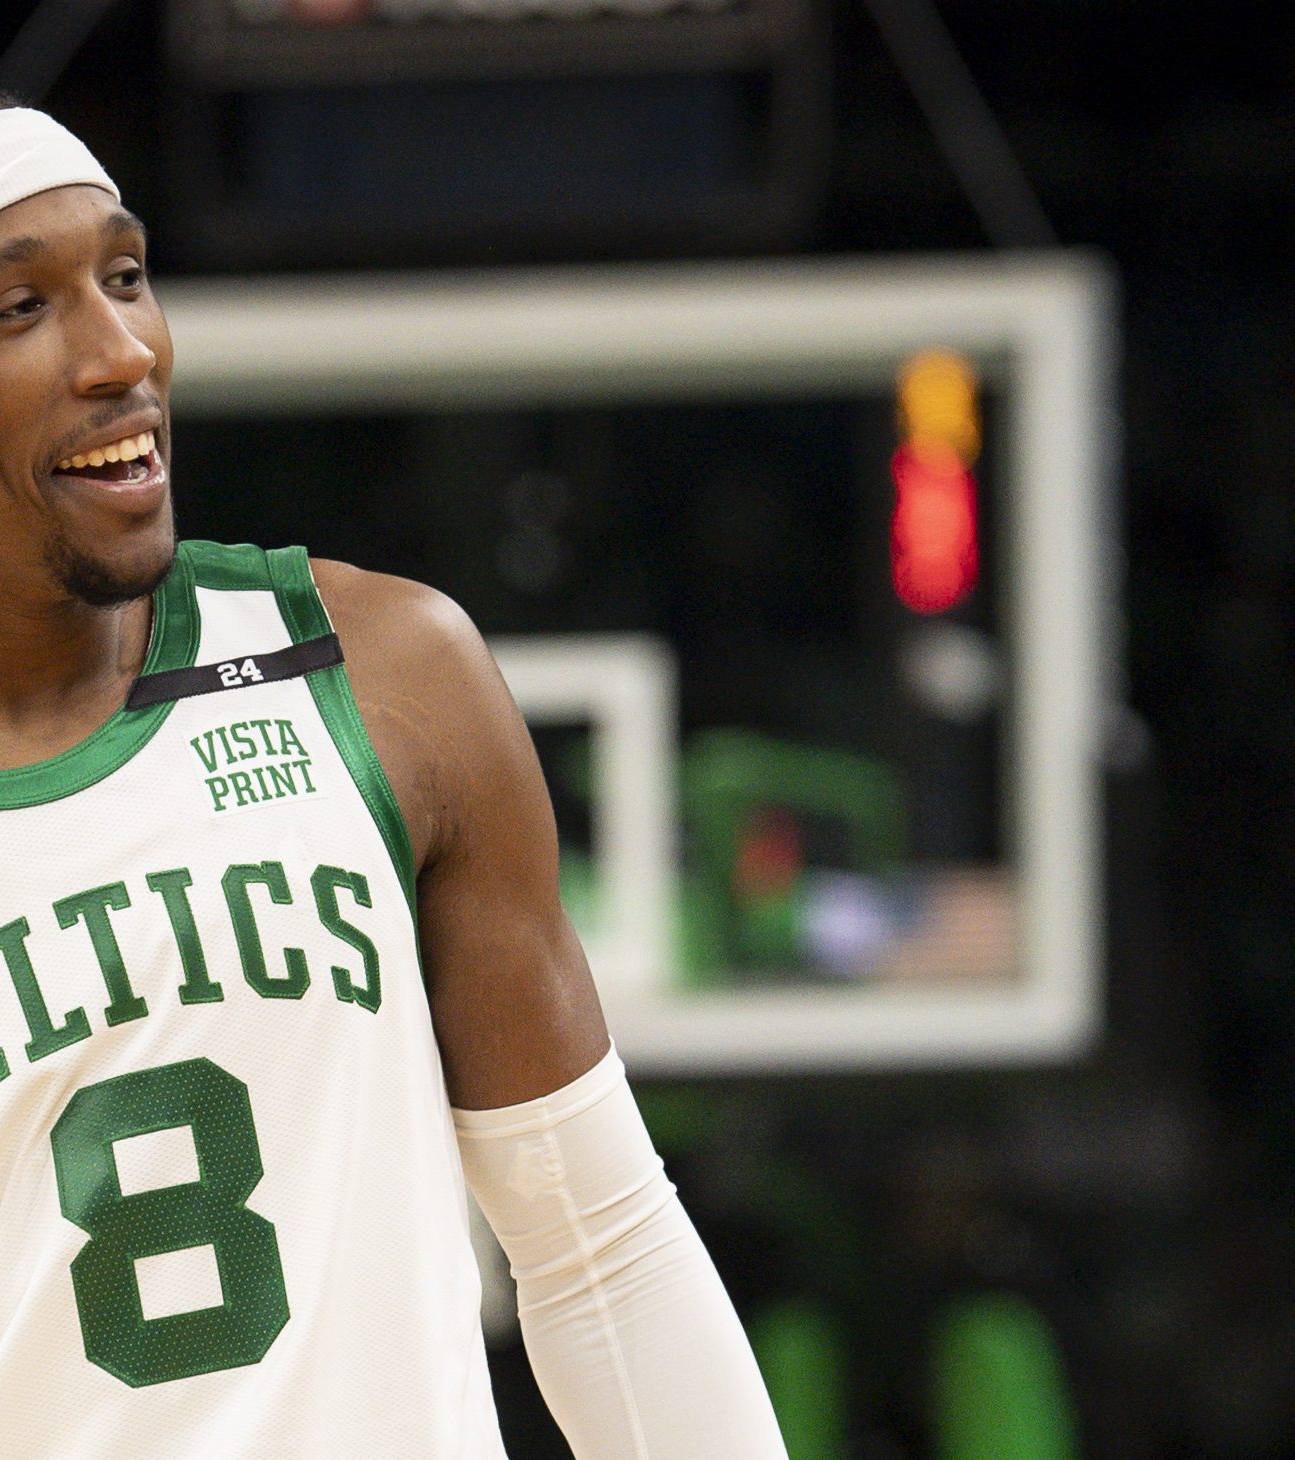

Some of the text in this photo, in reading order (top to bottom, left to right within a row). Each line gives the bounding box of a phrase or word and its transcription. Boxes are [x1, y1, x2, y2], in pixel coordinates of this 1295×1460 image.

[217, 658, 264, 687] 24
[190, 719, 308, 773] VISTA
[205, 759, 316, 812] PRINT
[50, 1056, 291, 1389] 8
